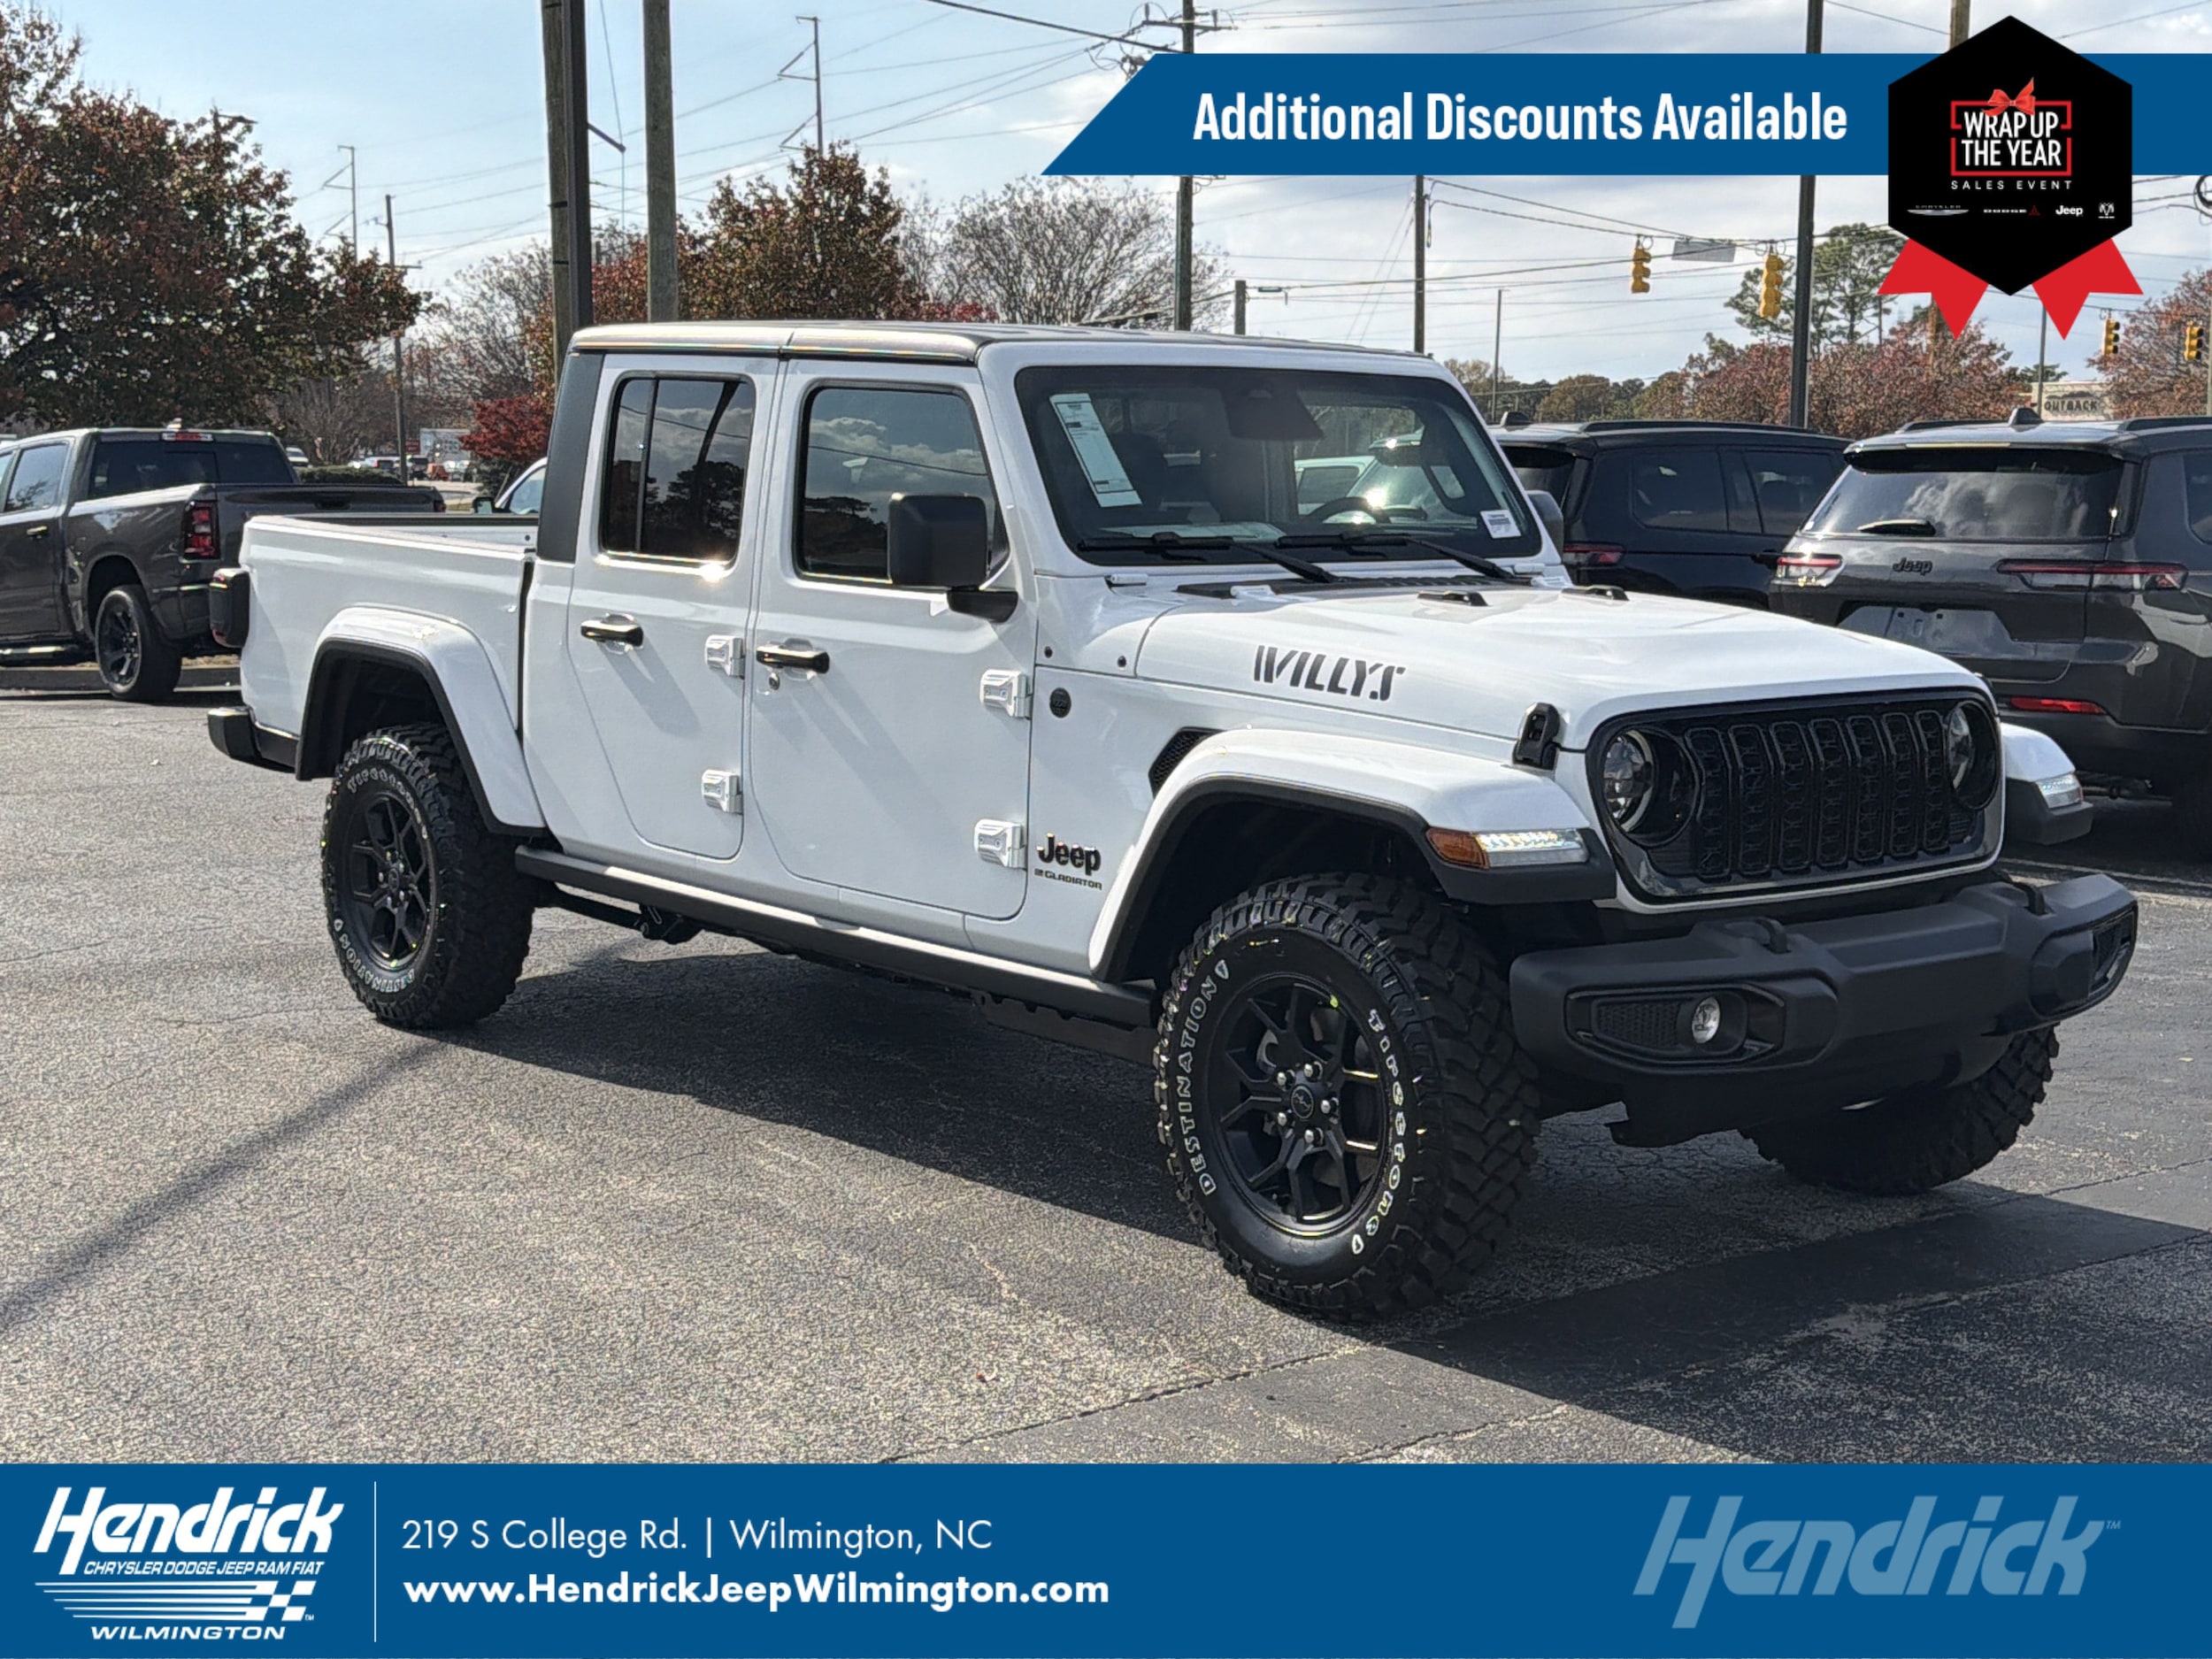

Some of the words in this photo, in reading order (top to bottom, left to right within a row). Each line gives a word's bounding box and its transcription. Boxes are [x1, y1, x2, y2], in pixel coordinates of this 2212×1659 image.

[1892, 557, 1933, 575] Jeep
[1254, 645, 1407, 702] WILLYS
[1036, 832, 1102, 876] Jeep
[1045, 870, 1102, 890] GLADIATOR
[1177, 977, 1218, 1196] DESTINATION
